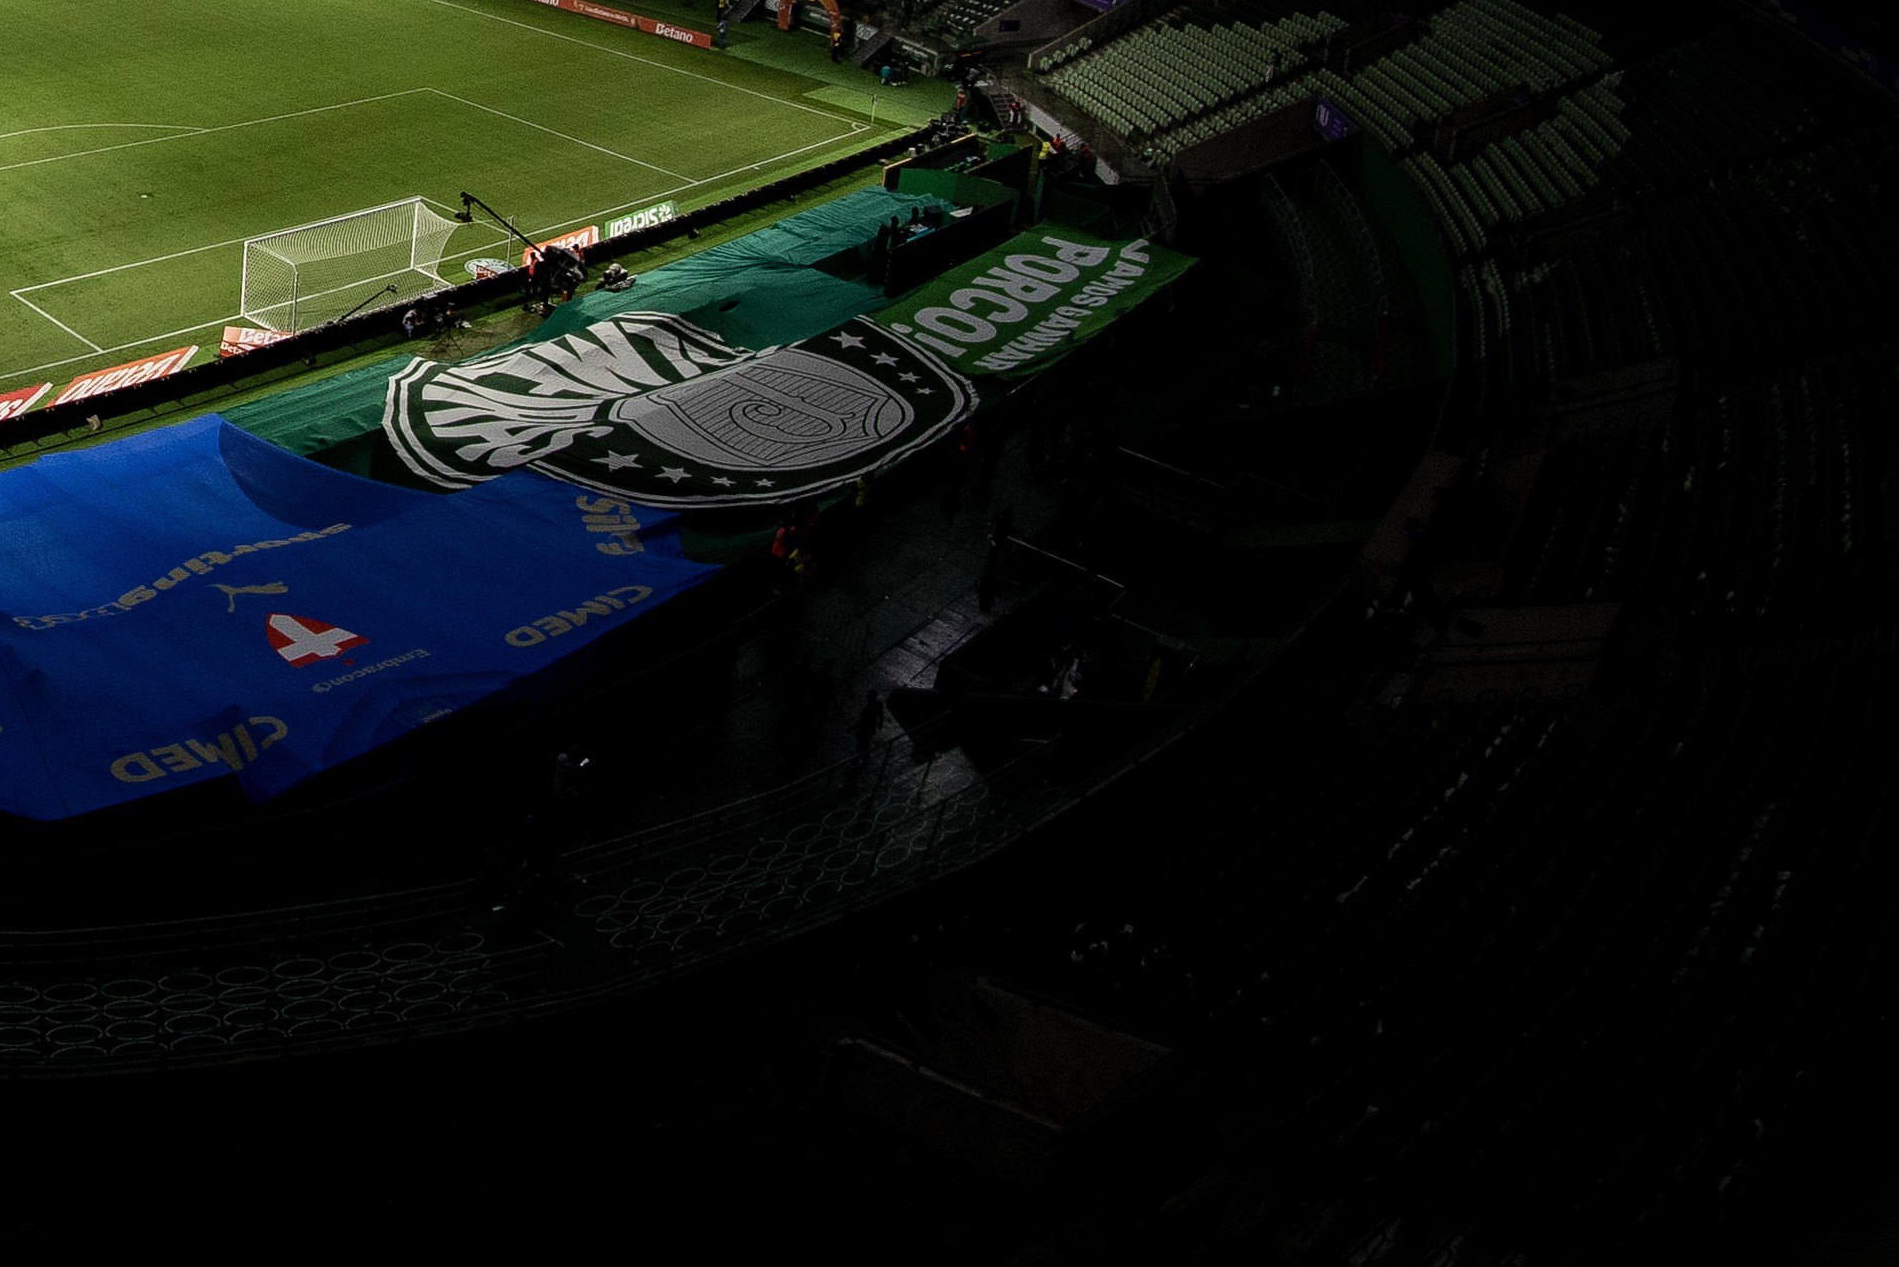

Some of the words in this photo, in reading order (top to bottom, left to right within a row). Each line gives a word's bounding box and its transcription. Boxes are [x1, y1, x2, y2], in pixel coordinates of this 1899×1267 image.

[655, 23, 694, 44] Betano
[890, 235, 1111, 359] PORCO!
[972, 305, 1094, 371] GANHAR
[11, 522, 353, 632] sportingbet
[504, 585, 653, 648] CIMED
[311, 647, 432, 695] Embracon
[109, 715, 290, 784] CIMED
